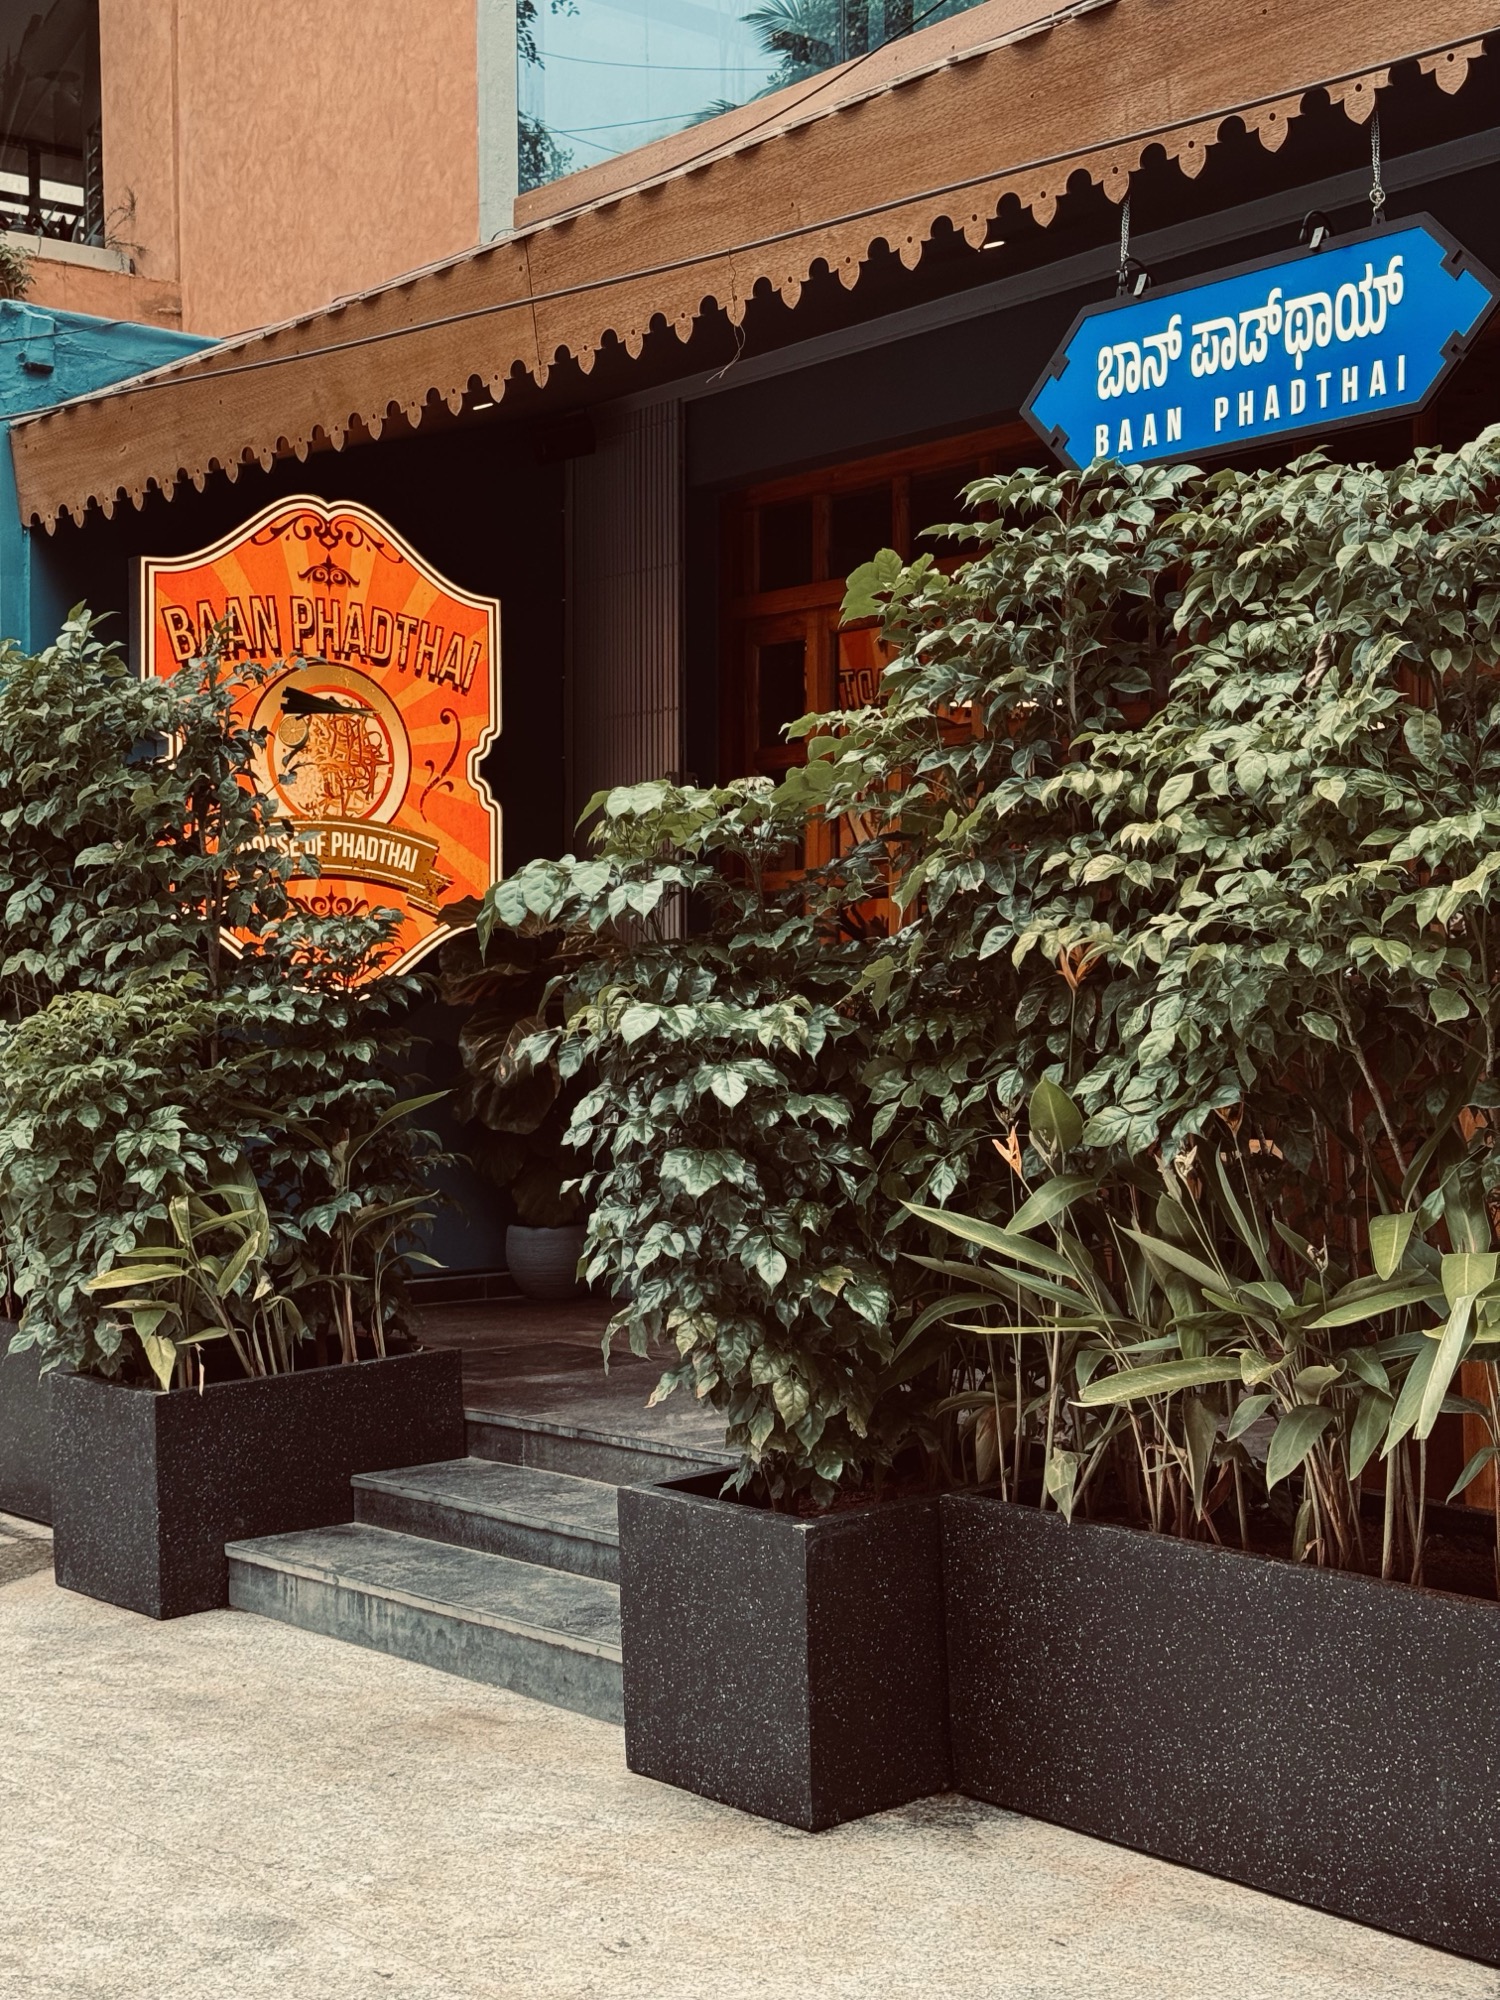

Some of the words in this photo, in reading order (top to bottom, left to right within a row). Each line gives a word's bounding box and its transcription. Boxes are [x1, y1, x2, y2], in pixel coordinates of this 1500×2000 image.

[1096, 313, 1183, 401] ಬಾನ್
[1094, 407, 1183, 458] BAAN
[1213, 354, 1407, 433] PHADTHAI
[161, 595, 282, 665] BAAN
[290, 596, 483, 695] PHADTHAI
[304, 831, 328, 857] OF
[331, 831, 420, 873] PHADTHAI
